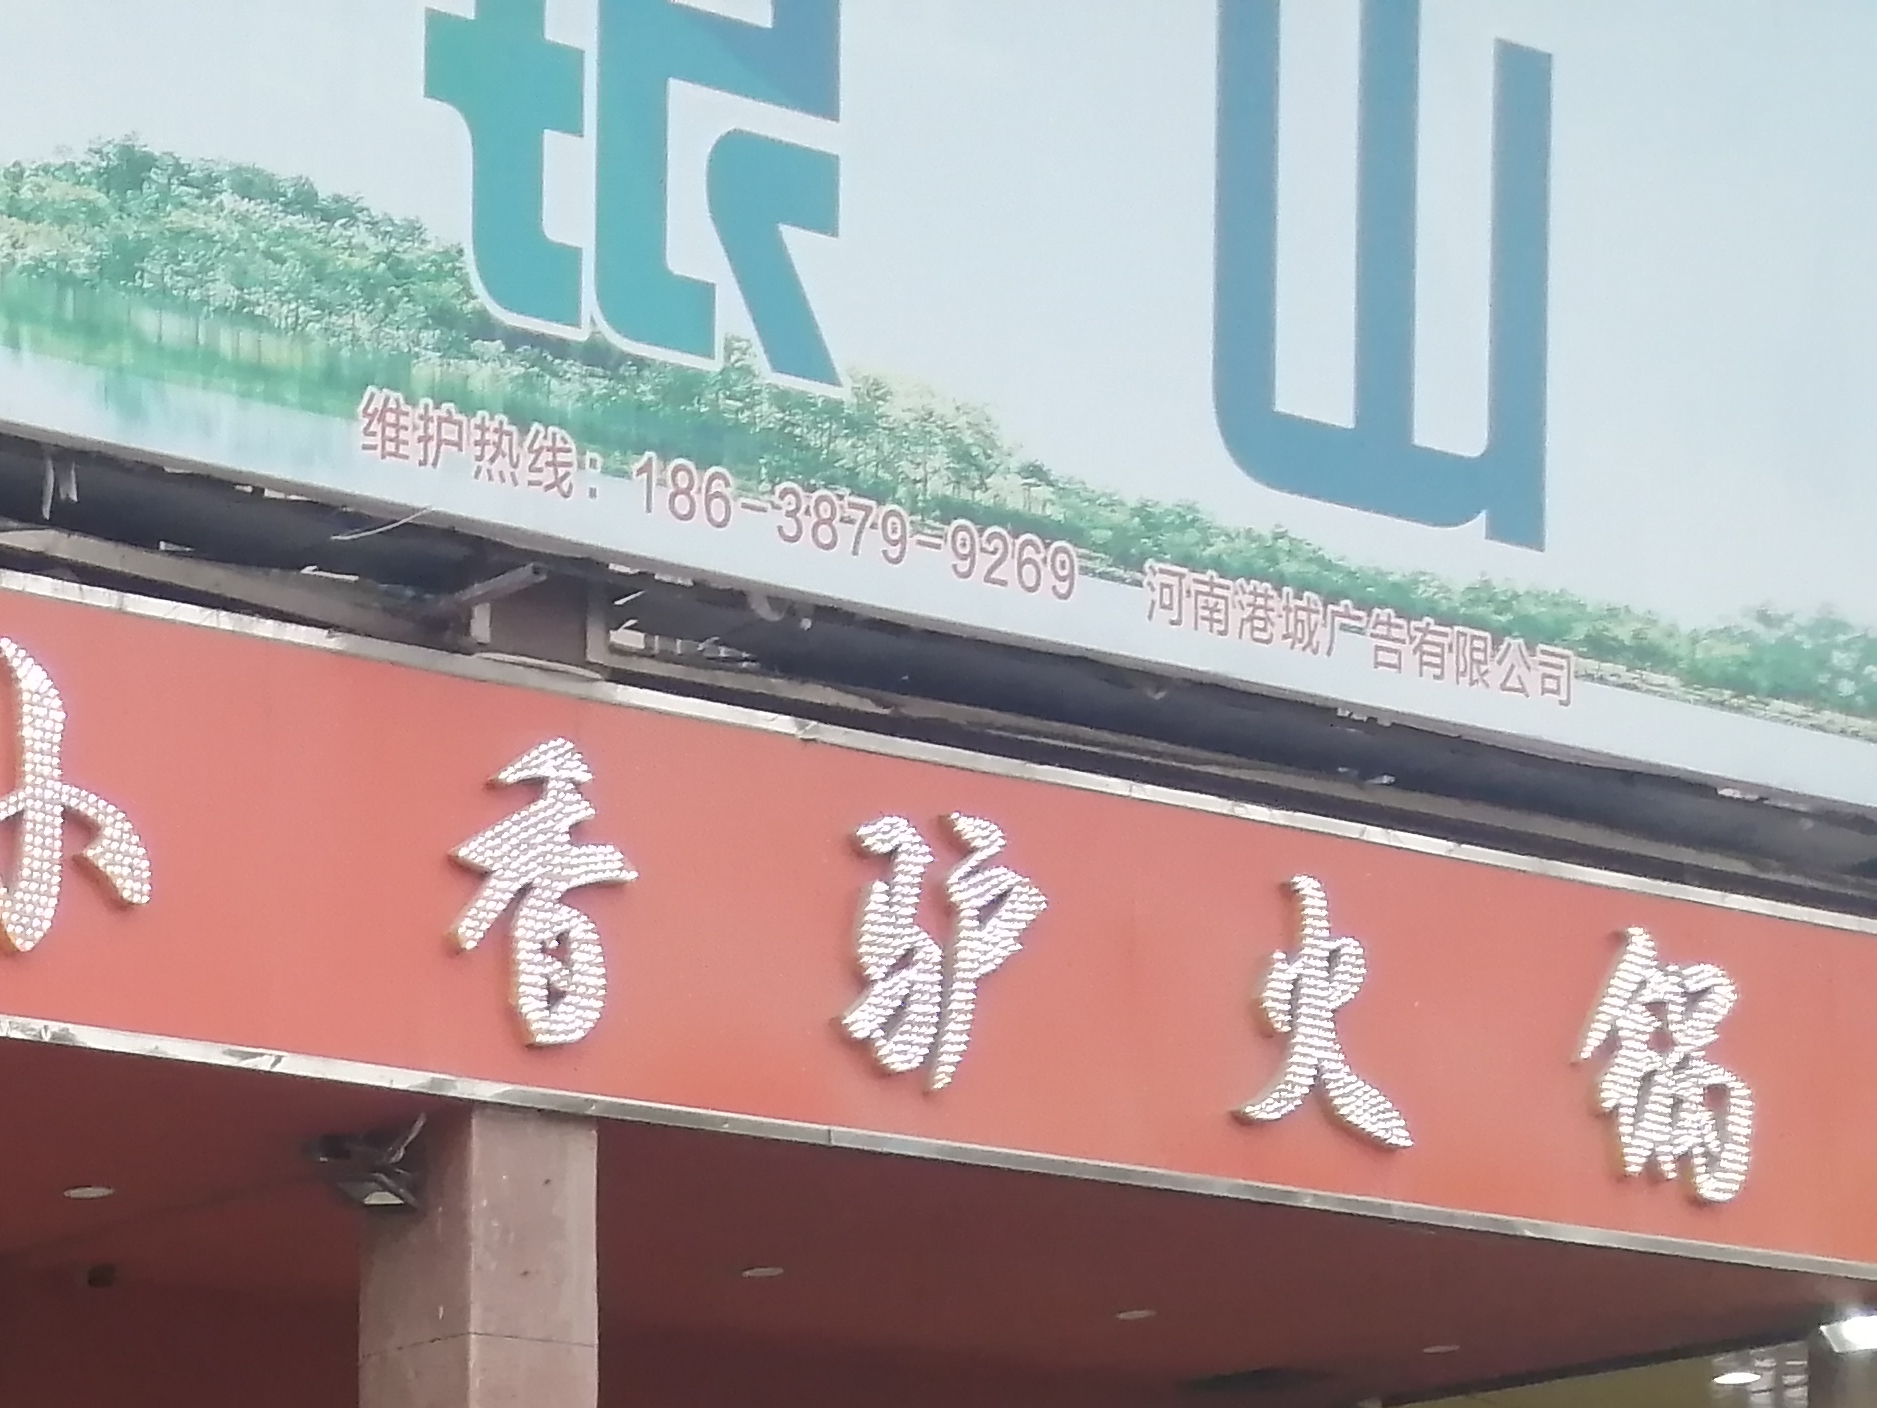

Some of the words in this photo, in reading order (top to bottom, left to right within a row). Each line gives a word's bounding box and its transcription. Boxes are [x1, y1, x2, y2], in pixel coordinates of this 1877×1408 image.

[1144, 562, 1575, 707] 河南港城广告有限公司
